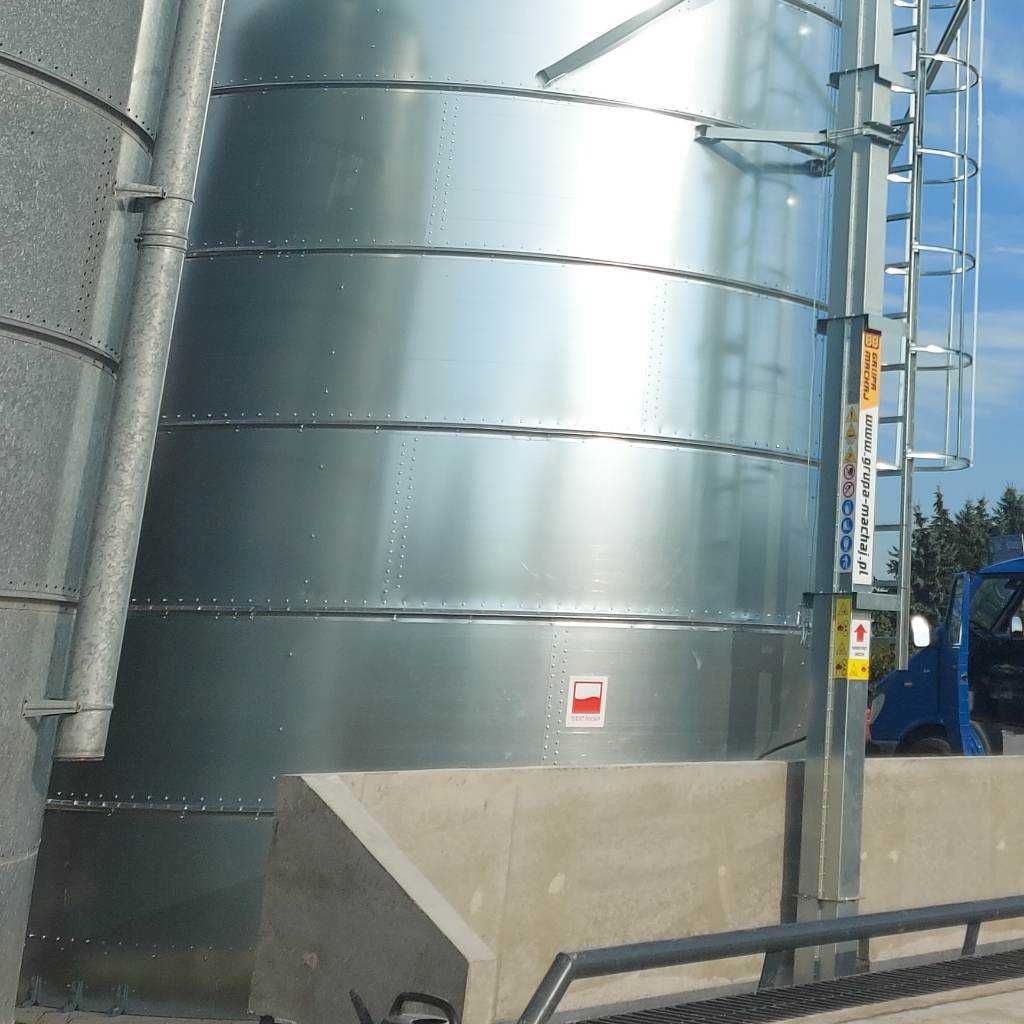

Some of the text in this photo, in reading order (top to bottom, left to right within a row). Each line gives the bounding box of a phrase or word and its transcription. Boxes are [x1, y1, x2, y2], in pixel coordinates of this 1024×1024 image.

[863, 351, 871, 400] MACHAJ
[870, 352, 878, 391] GRUPA
[857, 414, 873, 576] www.grupa-machaj.pl
